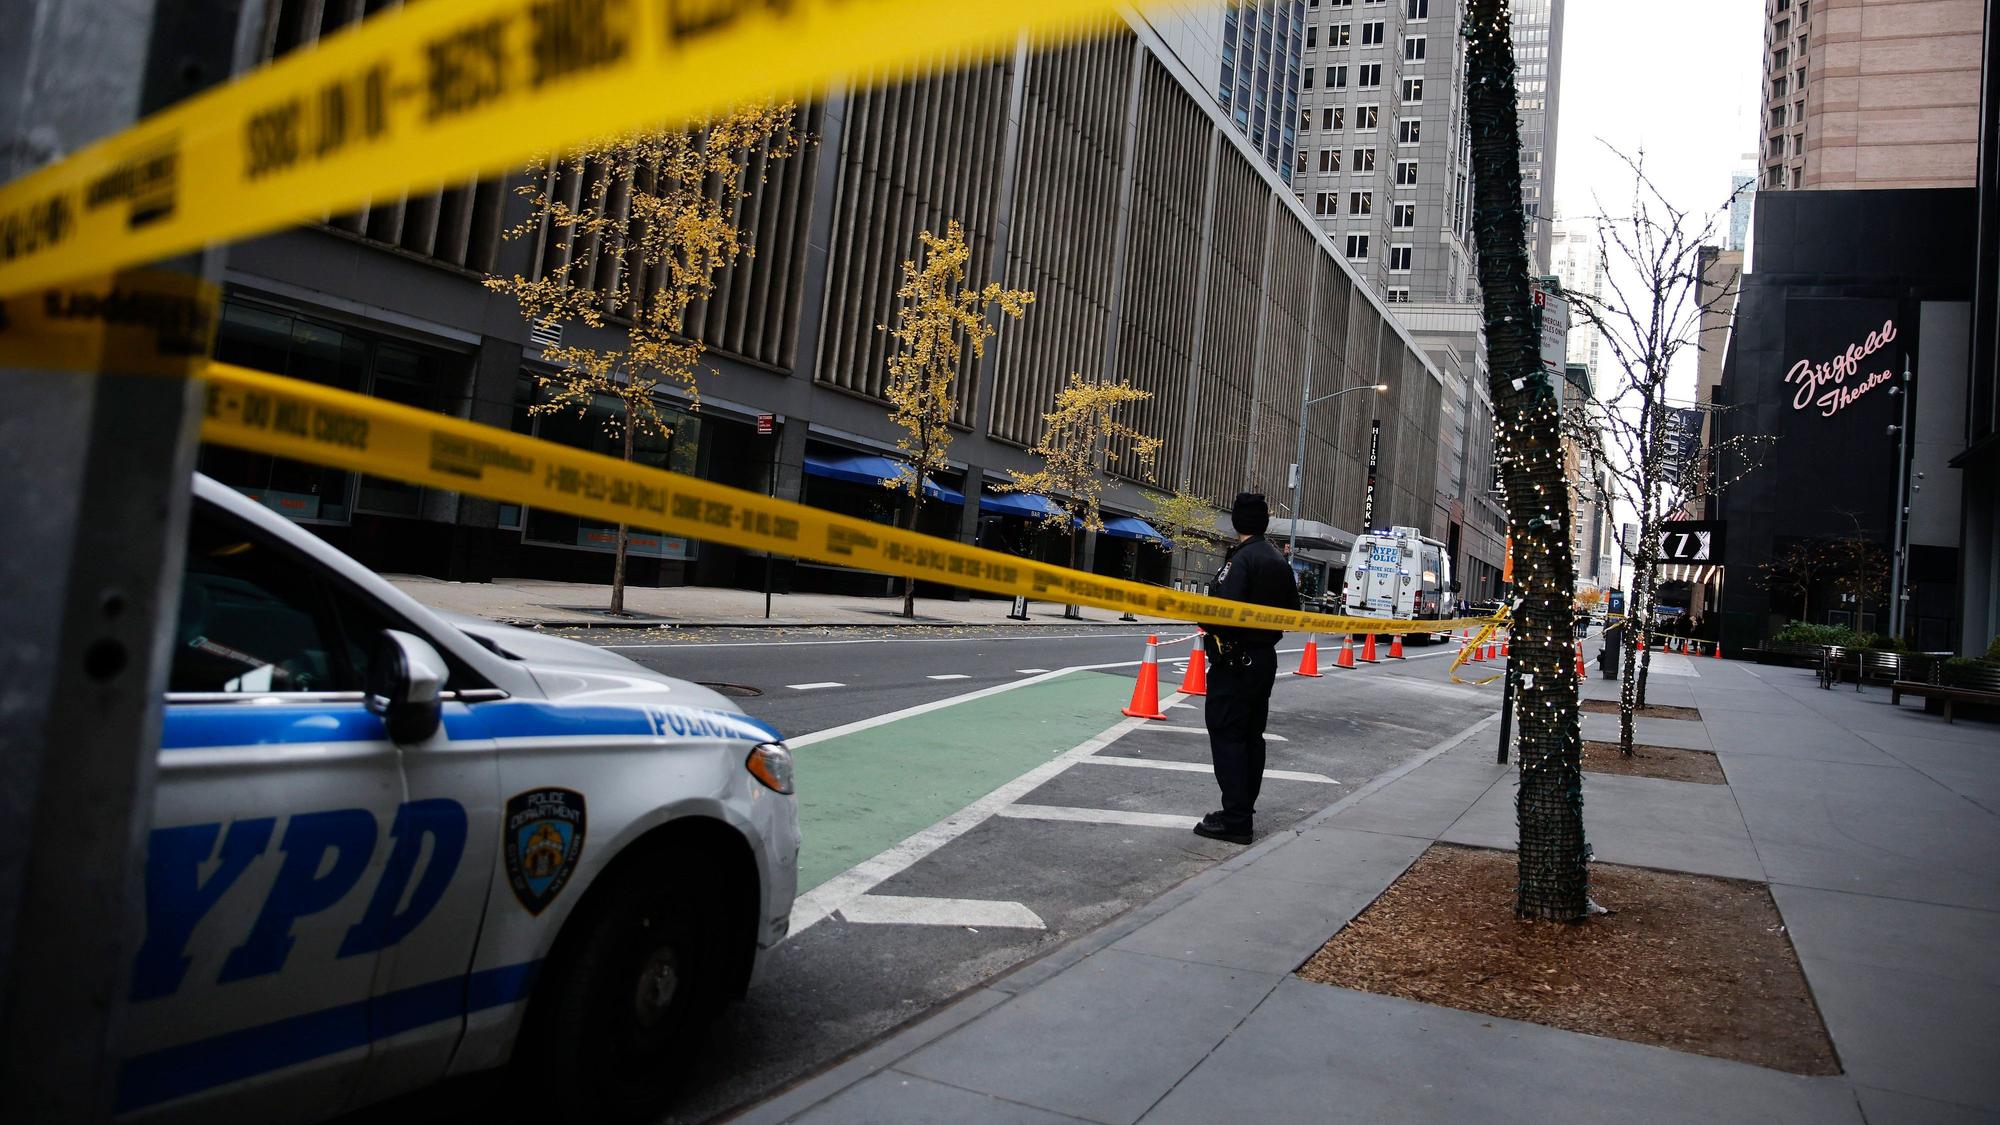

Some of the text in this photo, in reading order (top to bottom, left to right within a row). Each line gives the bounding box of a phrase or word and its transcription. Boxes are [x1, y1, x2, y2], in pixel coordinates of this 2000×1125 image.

[1784, 319, 1897, 410] Ziegfeld
[1816, 369, 1892, 417] Theatre
[1370, 427, 1379, 466] Hilton
[1030, 510, 1041, 518] BAR
[1366, 485, 1374, 519] PARK
[1373, 546, 1398, 556] NYPD
[1613, 599, 1620, 608] P
[650, 709, 740, 739] POLICE
[528, 791, 565, 805] POLICE
[511, 804, 580, 830] DEPARTMENT
[568, 833, 581, 861] YORK
[128, 798, 468, 1004] YPD
